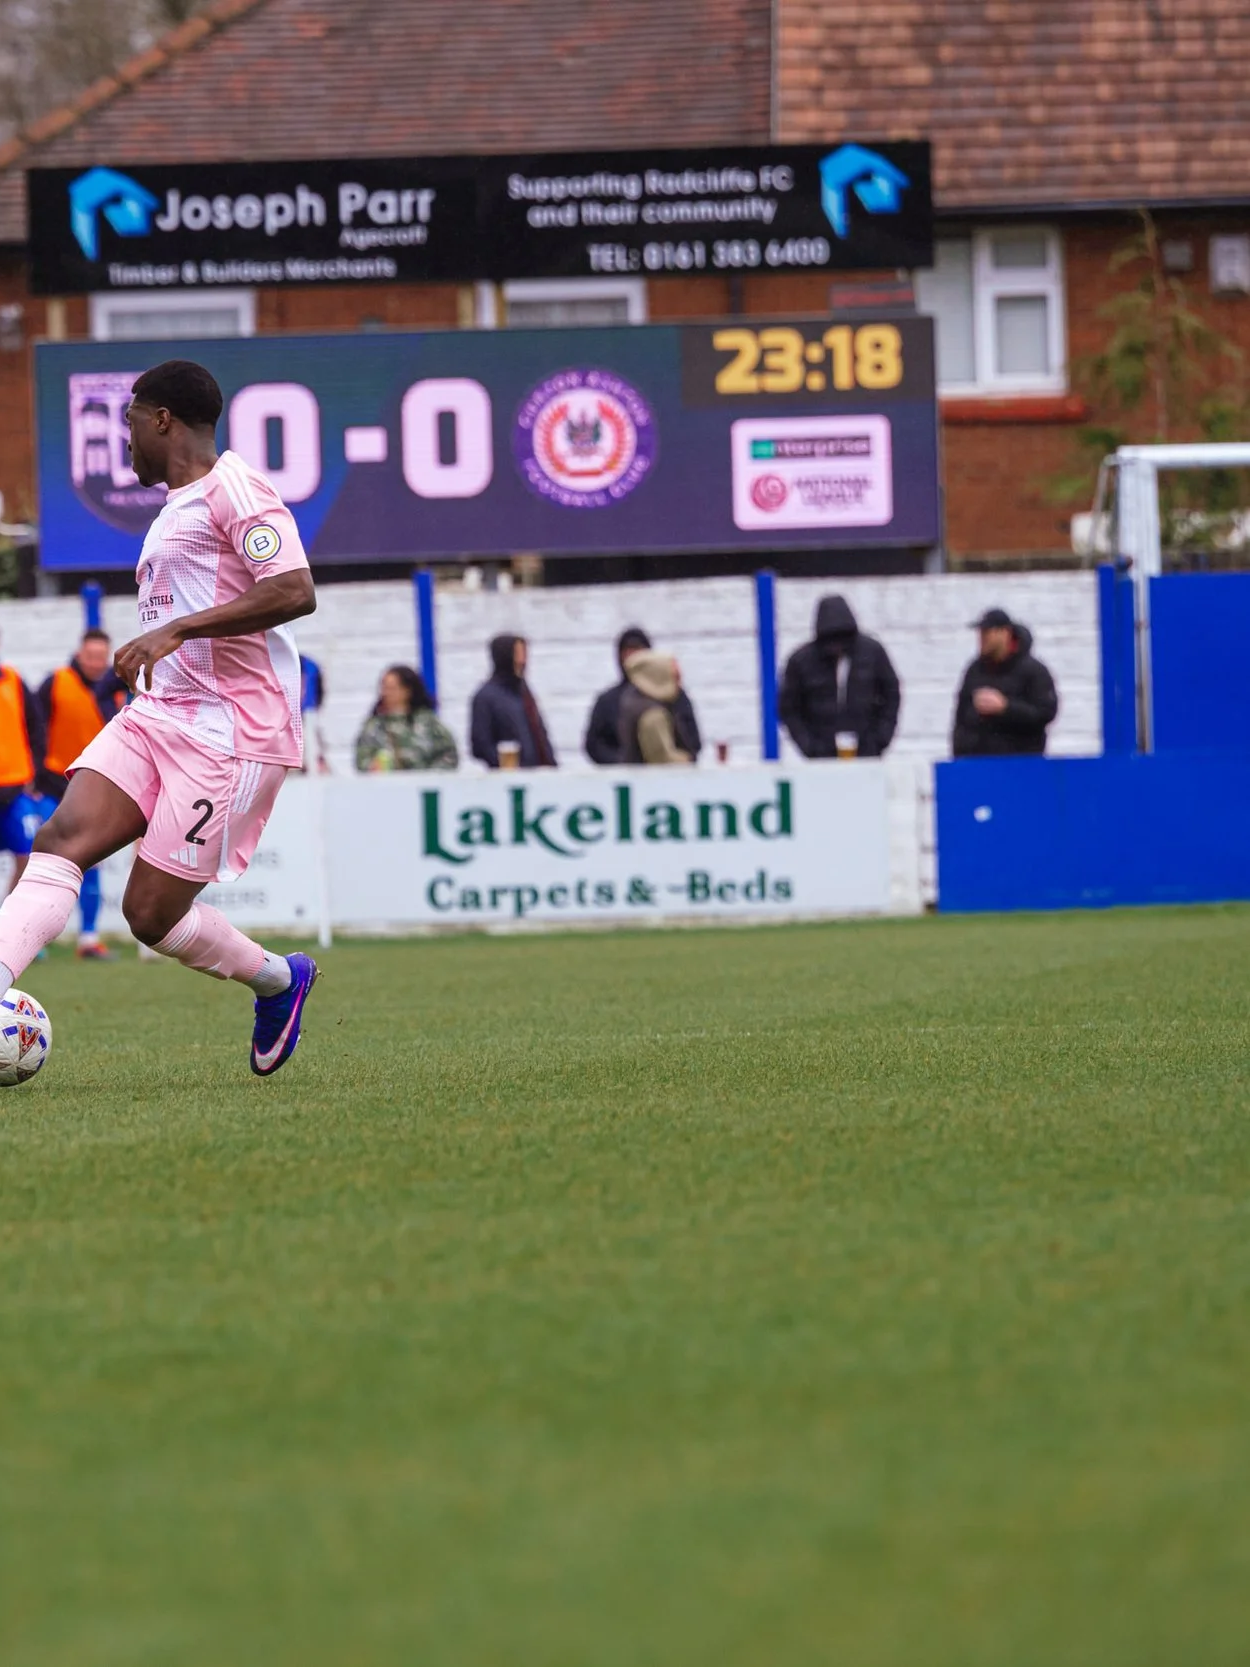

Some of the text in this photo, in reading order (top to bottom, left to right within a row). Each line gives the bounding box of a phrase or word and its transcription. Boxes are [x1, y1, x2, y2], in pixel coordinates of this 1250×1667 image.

[508, 165, 794, 202] Supporting Radcliffe FC
[155, 183, 435, 236] Joseph Parr
[527, 198, 777, 227] and their community
[339, 225, 428, 250] Agecroft
[588, 244, 640, 271] TEL:
[643, 241, 706, 269] 0161
[765, 237, 830, 266] 6400
[108, 257, 397, 286] Timber & Builders Merchants
[713, 323, 903, 394] 23:18
[230, 382, 321, 503] 0
[402, 377, 491, 499] 0
[253, 535, 270, 552] B
[185, 799, 213, 846] 2
[420, 778, 793, 866] Lakeland
[426, 874, 615, 919] Carpets
[625, 876, 659, 906] &
